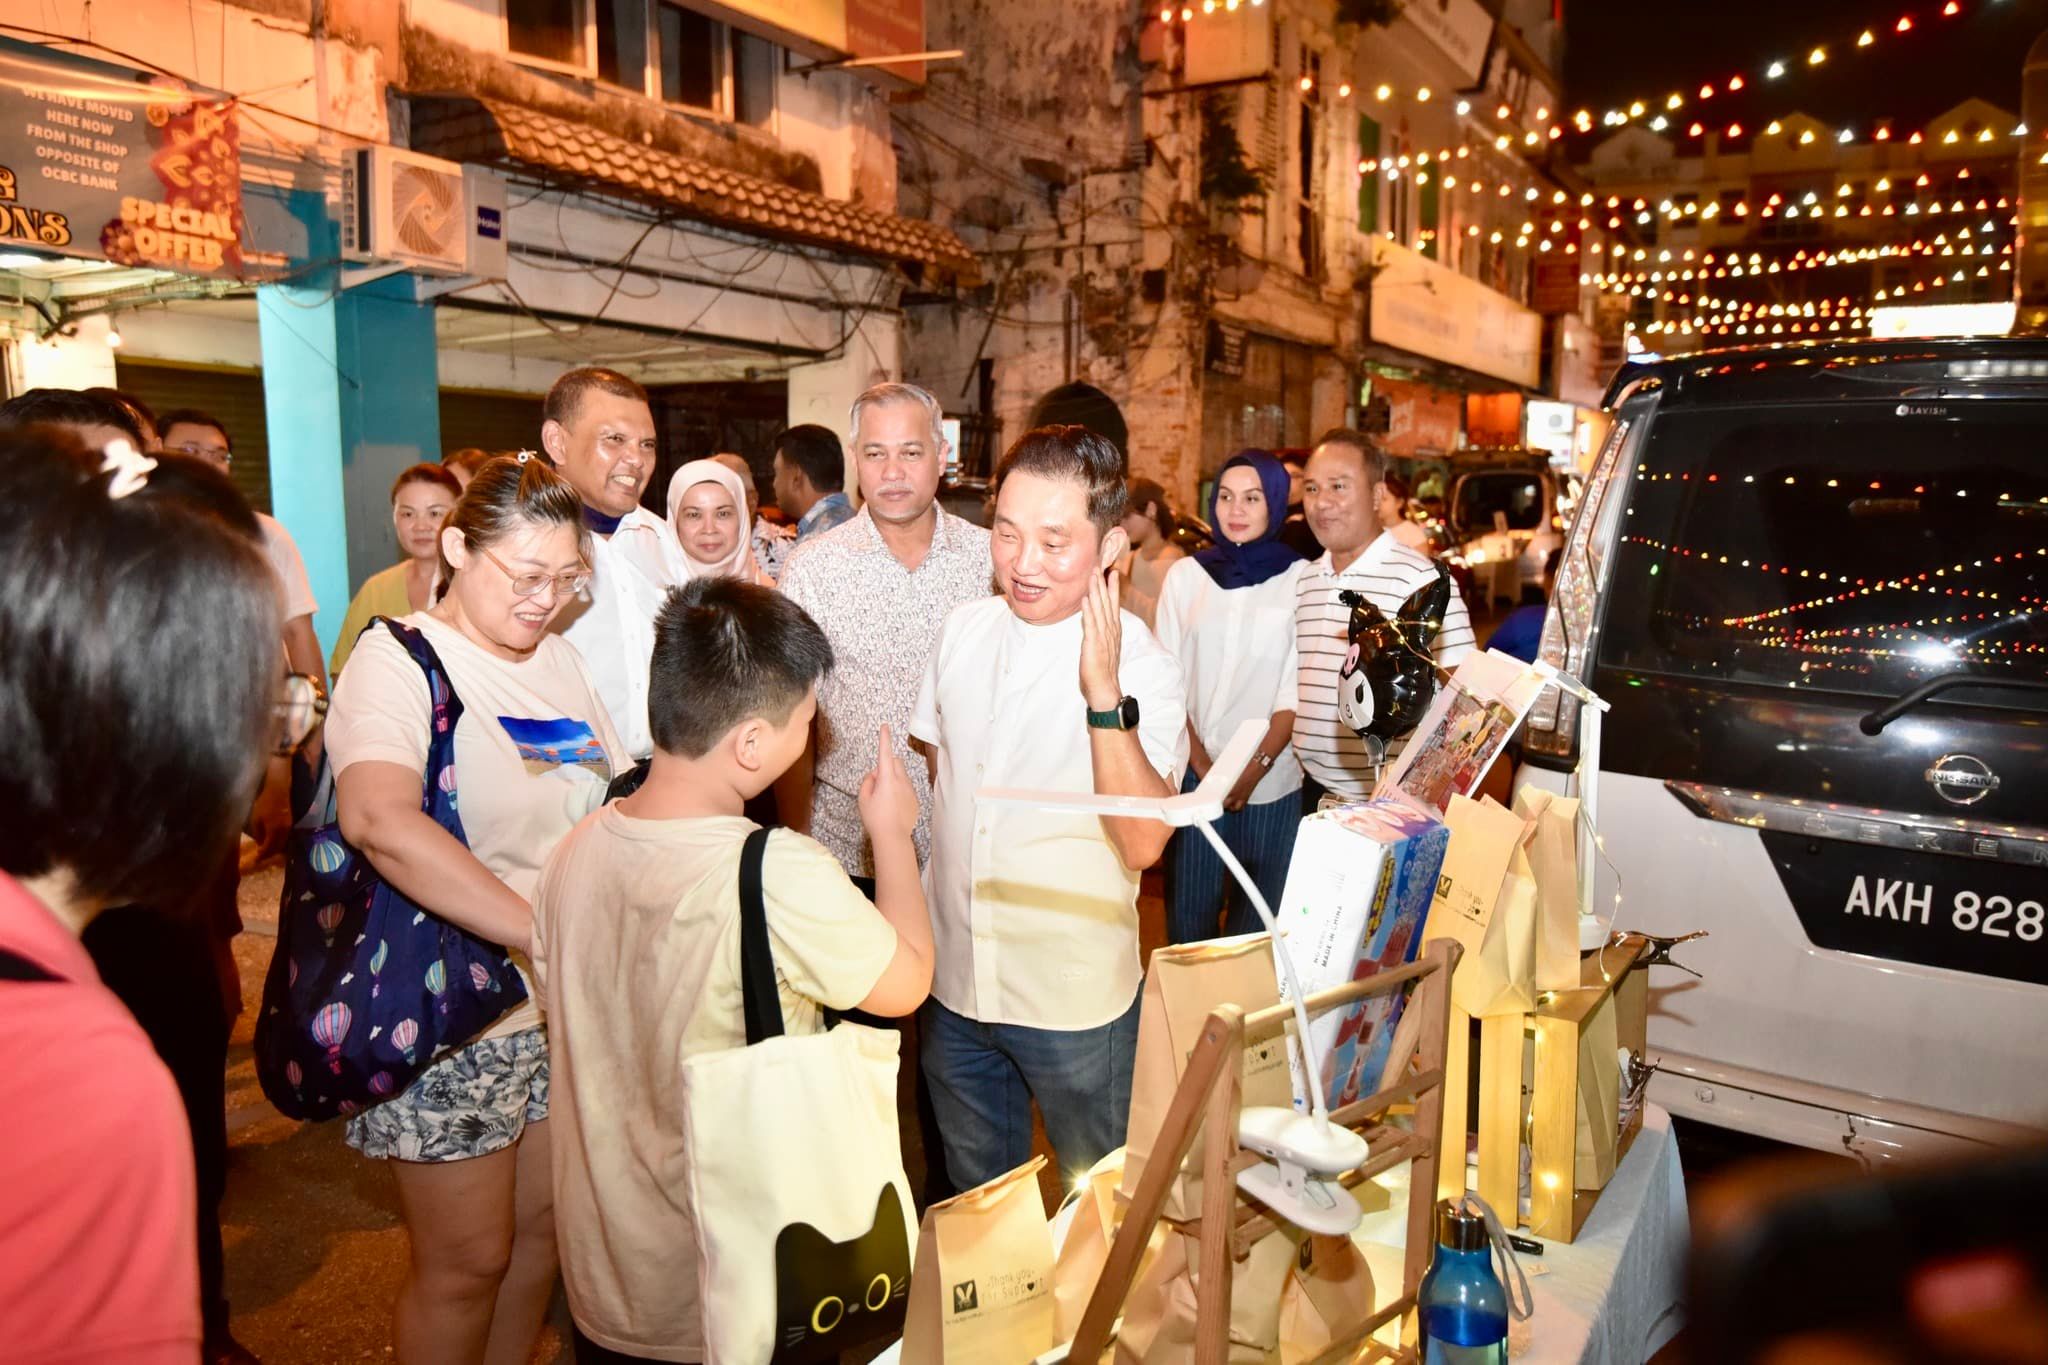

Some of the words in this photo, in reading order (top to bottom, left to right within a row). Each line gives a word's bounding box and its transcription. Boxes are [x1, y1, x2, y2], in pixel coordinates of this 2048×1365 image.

[46, 109, 80, 128] HERE
[81, 118, 114, 136] NOW
[85, 101, 134, 122] MOVED
[26, 123, 66, 143] FROM
[69, 134, 92, 150] THE
[94, 140, 128, 157] SHOP
[35, 145, 101, 170] OPPOSITE
[102, 161, 120, 174] OF
[41, 166, 79, 184] OCBC
[80, 174, 118, 191] BANK
[120, 196, 236, 241] SPECIAL
[133, 227, 224, 268] OFFER
[1844, 875, 1933, 925] AKH
[1951, 890, 2045, 942] 828
